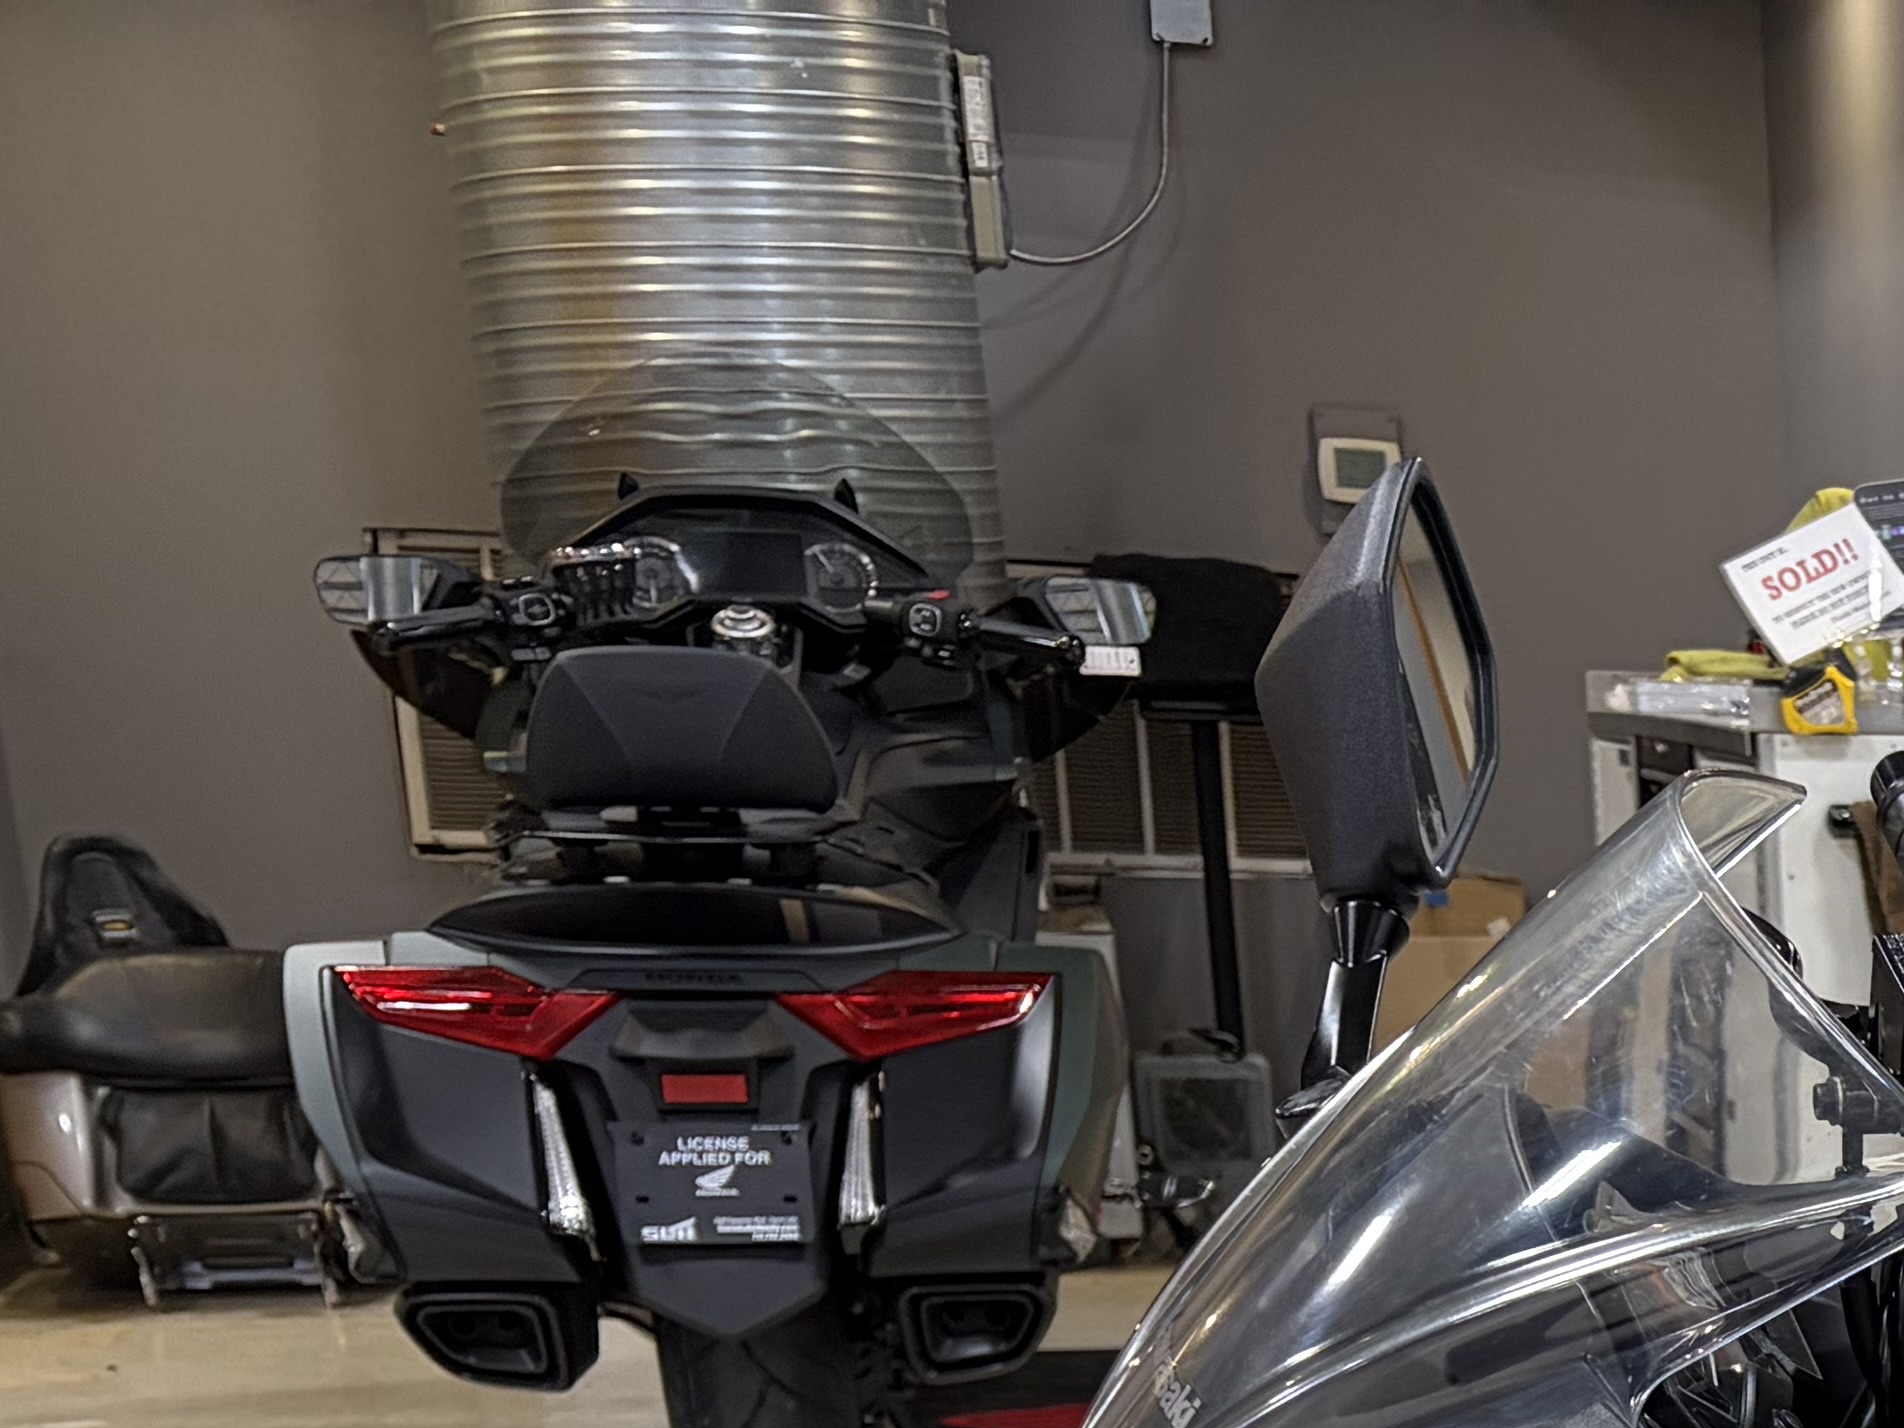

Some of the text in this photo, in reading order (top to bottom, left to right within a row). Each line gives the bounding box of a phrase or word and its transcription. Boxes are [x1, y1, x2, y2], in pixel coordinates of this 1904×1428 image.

[1761, 538, 1859, 601] SOLD!!
[676, 1136, 750, 1151] LICENSE
[658, 1150, 772, 1166] APPLIED FOR
